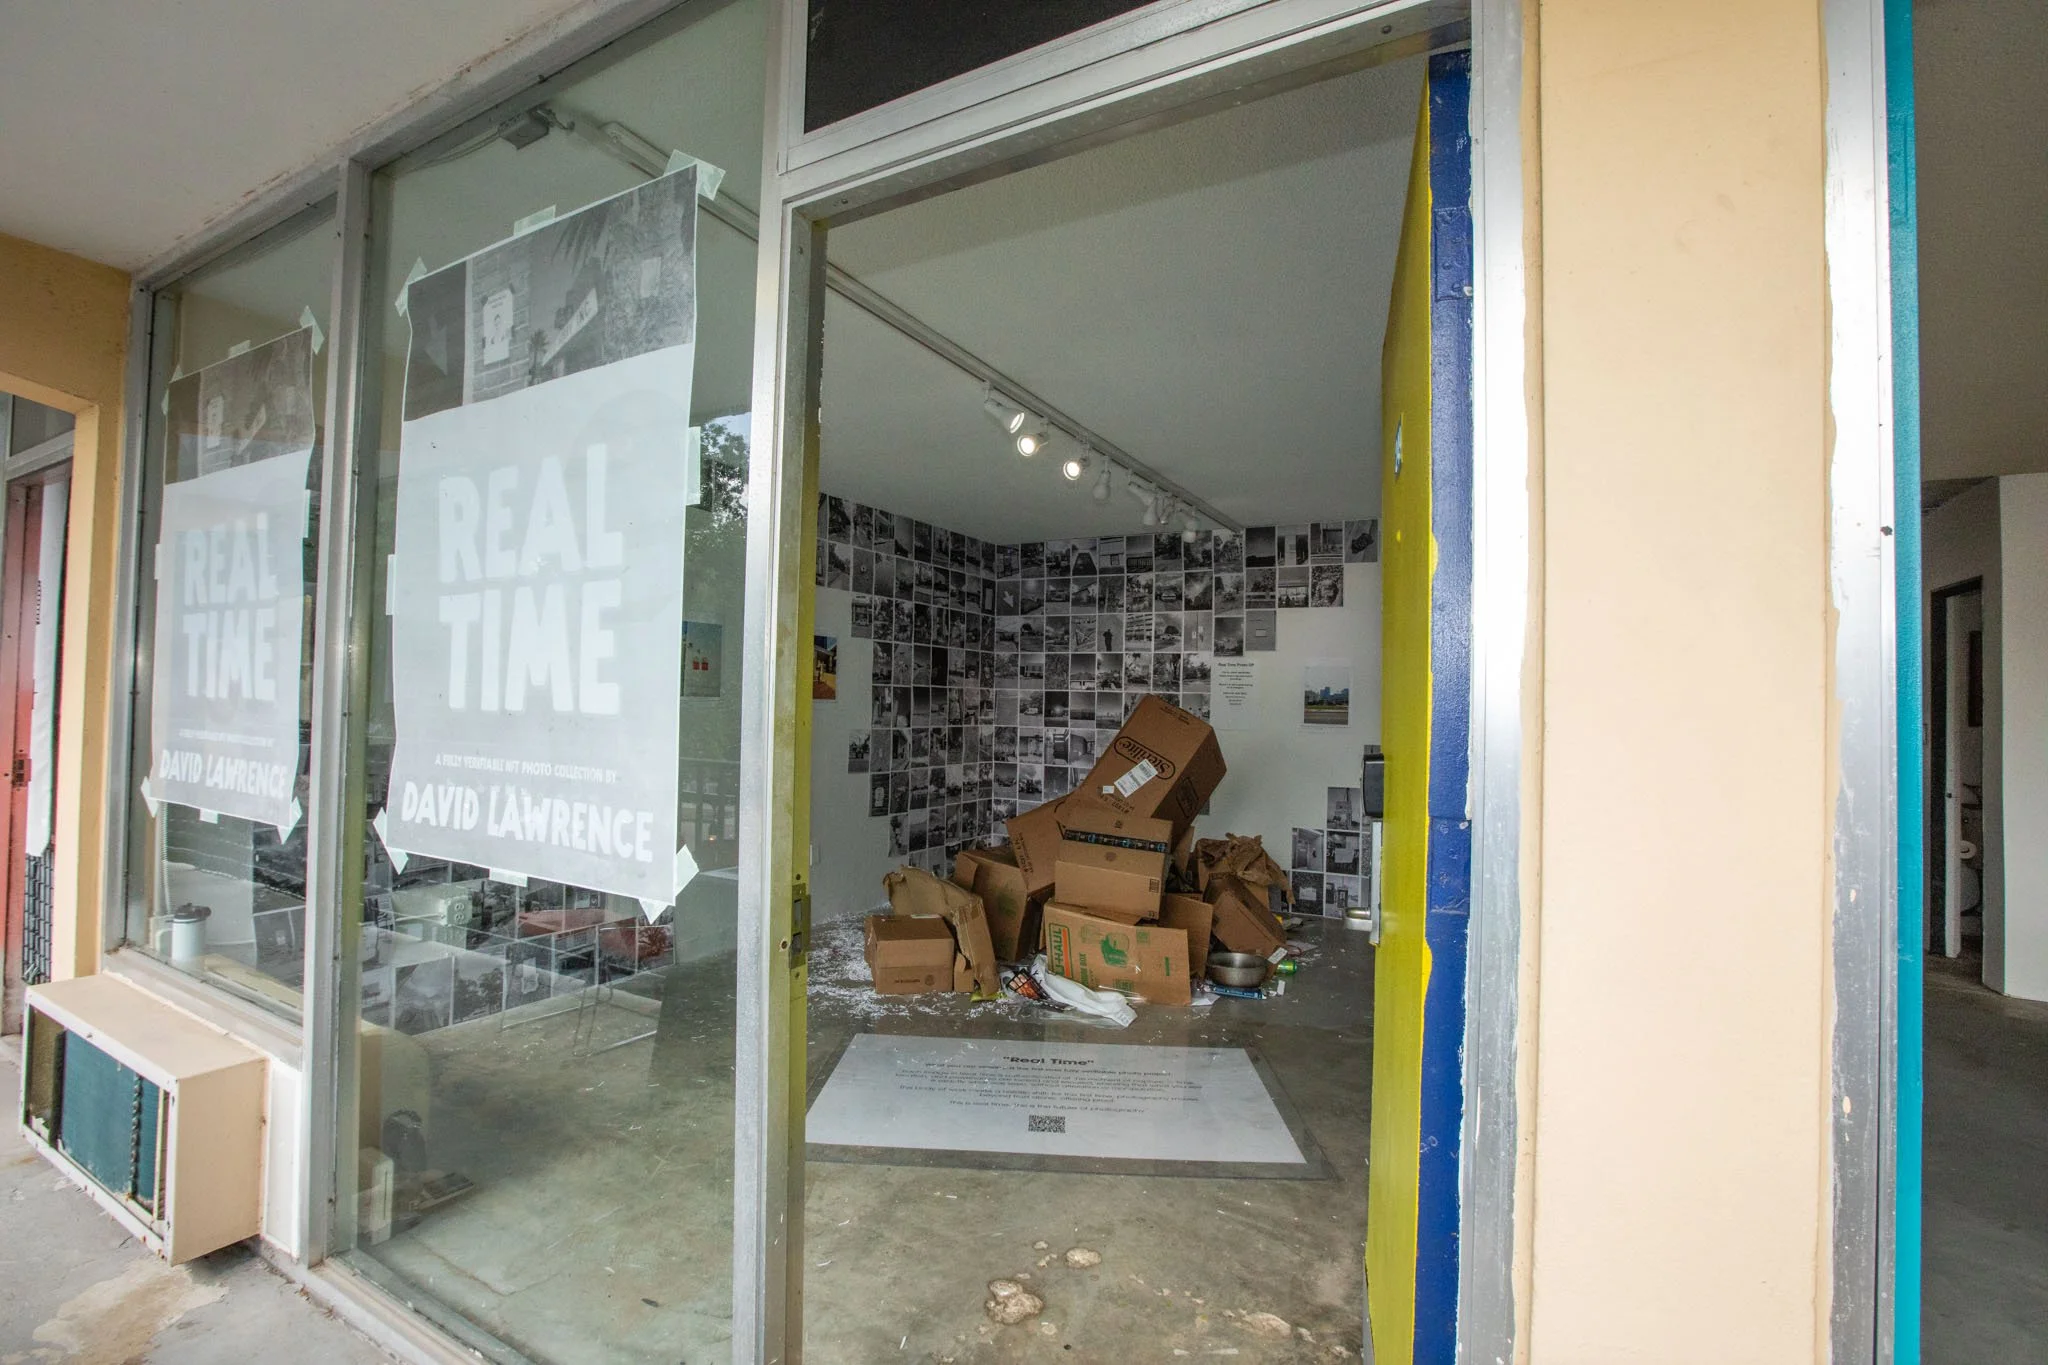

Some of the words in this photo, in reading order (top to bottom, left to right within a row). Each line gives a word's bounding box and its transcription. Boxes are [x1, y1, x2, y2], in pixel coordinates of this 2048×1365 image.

[438, 443, 623, 584] REAL
[182, 511, 279, 607] REAL
[182, 607, 277, 703] TIME
[439, 578, 621, 716] TIME
[158, 748, 202, 782] DAVID
[206, 754, 288, 799] LAWRENCE
[434, 752, 442, 767] A
[443, 754, 462, 768] FULLY
[463, 755, 504, 773] VERIFIABLE
[521, 761, 553, 777] PHOTO
[554, 764, 604, 784] COLLECTION
[605, 769, 618, 785] BY
[401, 781, 480, 832] DAVID
[486, 785, 655, 863] LAWRENCE
[1052, 928, 1064, 976] U-HAUL
[1003, 1056, 1044, 1064] "Real
[1050, 1058, 1094, 1066] Time"
